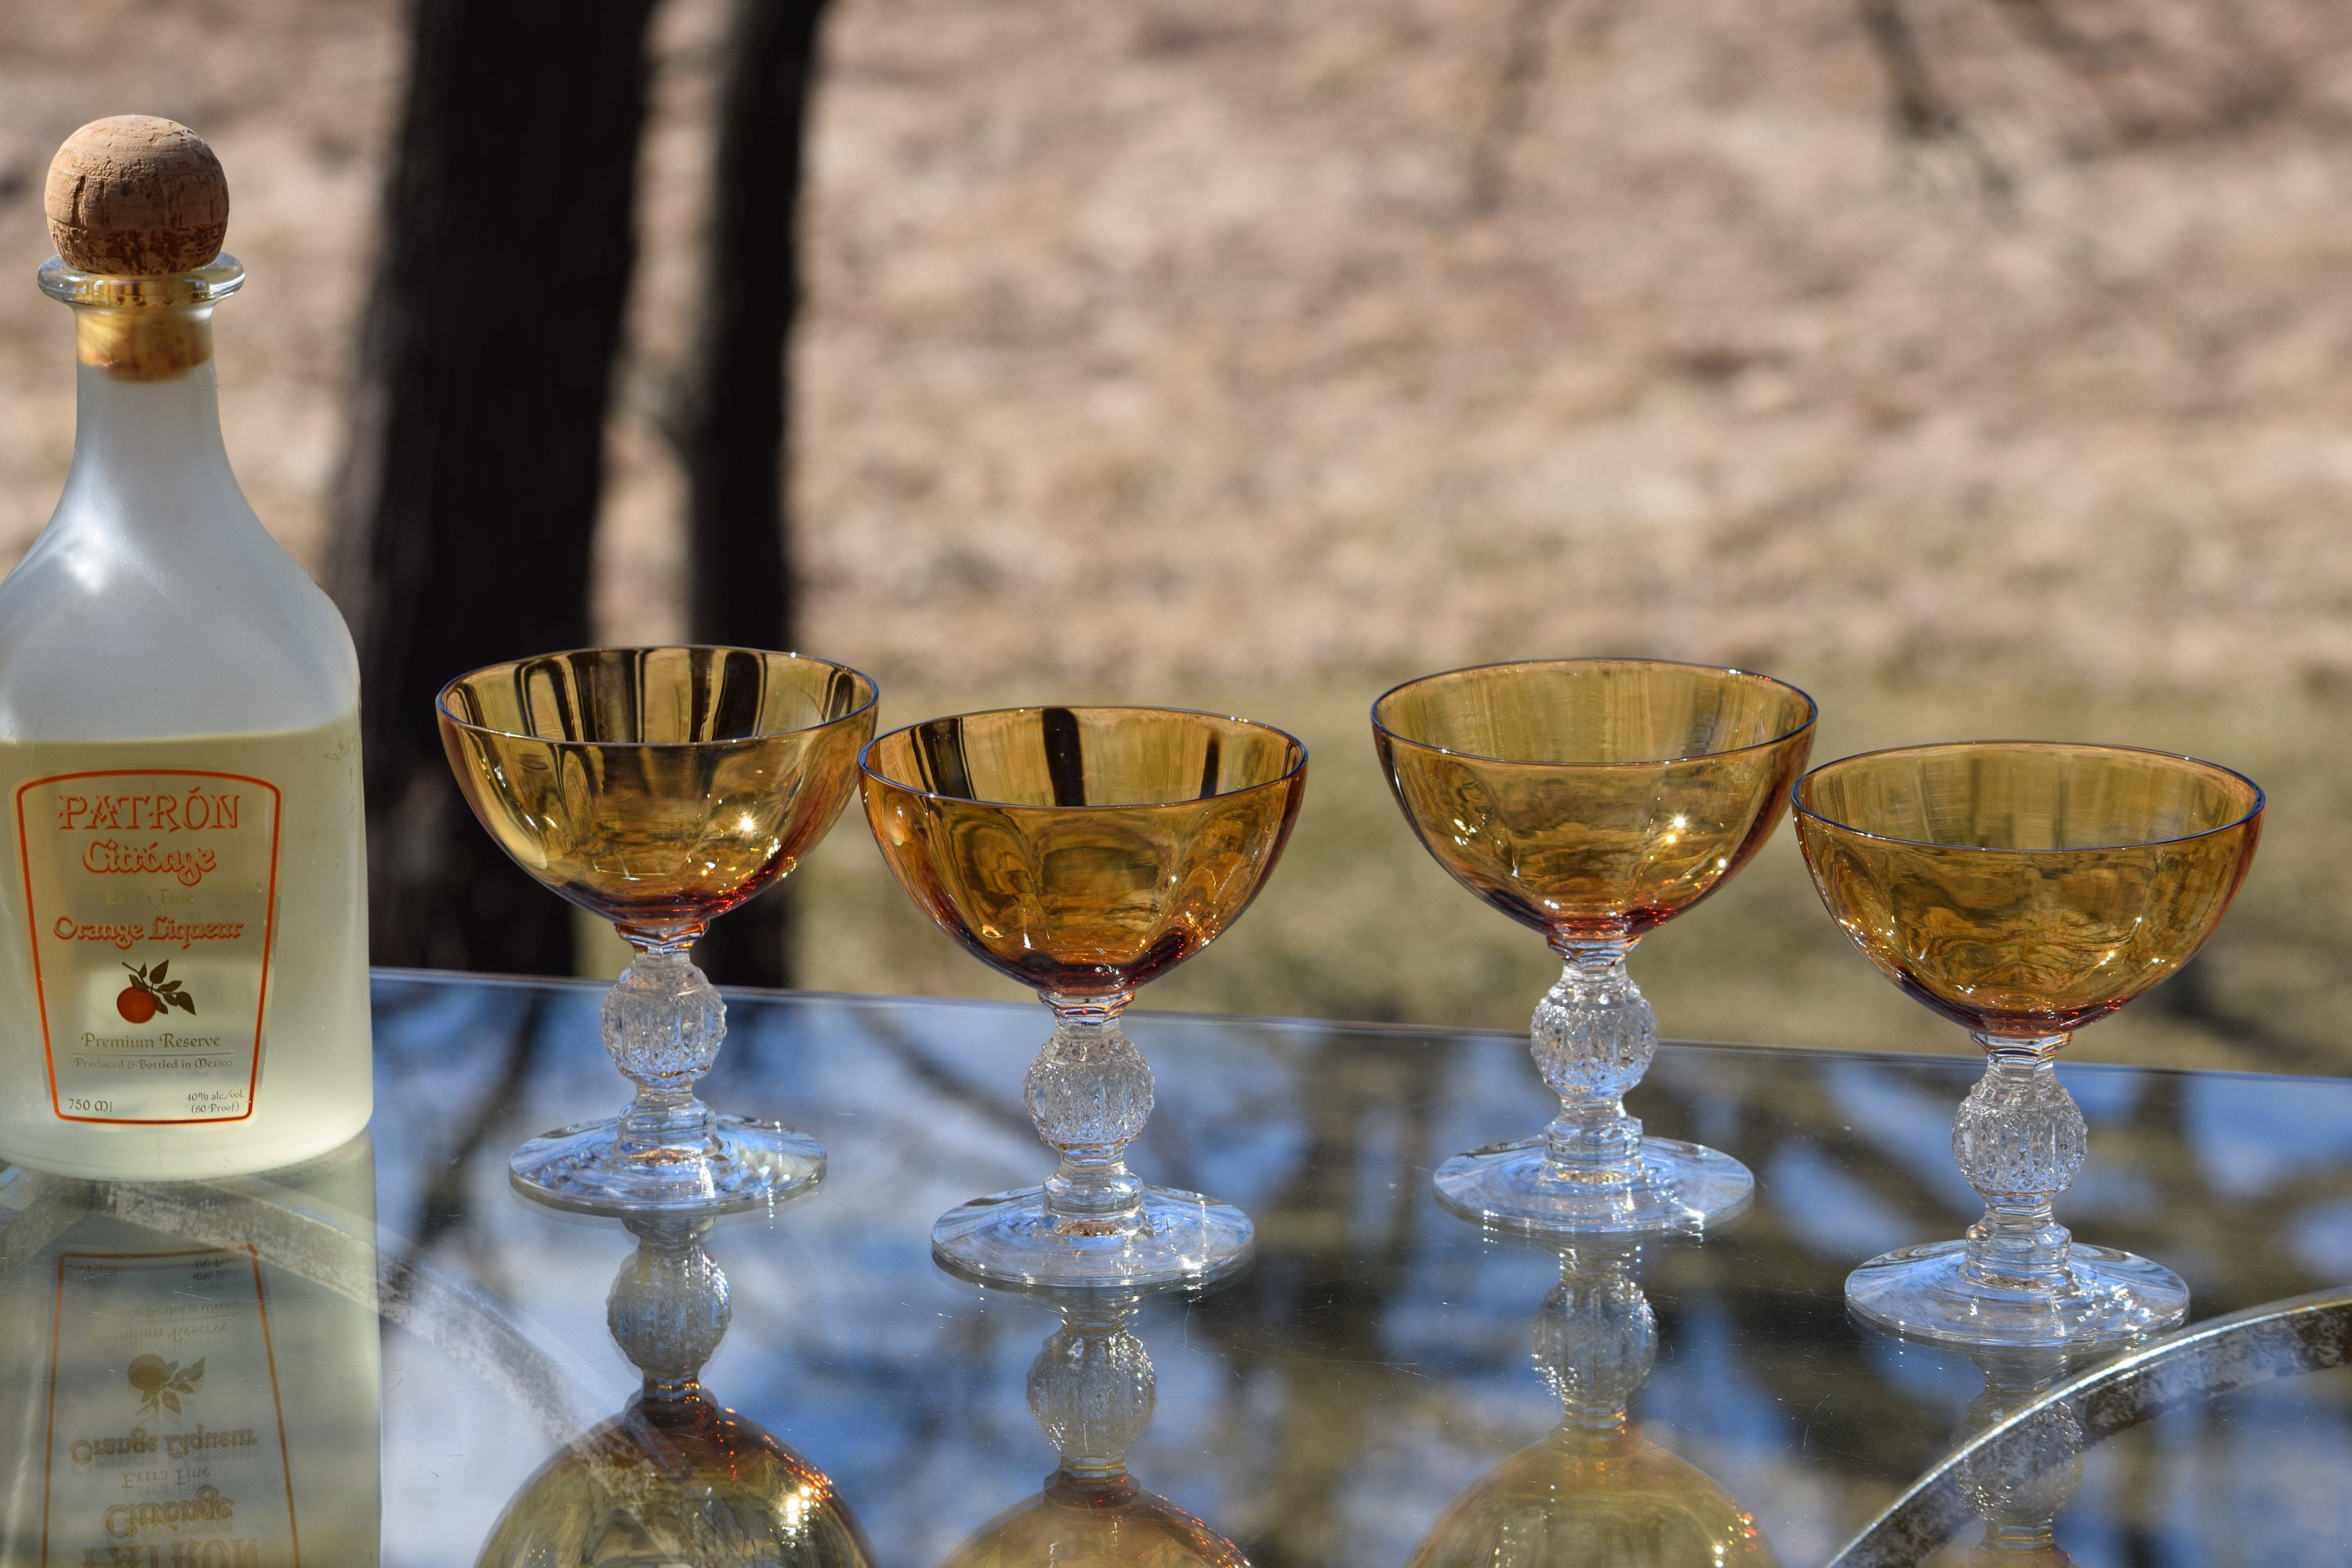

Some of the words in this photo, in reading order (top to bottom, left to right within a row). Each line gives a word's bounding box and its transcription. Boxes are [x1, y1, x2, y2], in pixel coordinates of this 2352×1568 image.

[58, 786, 241, 833] PATRÓN
[82, 838, 216, 887] Citrónge
[158, 887, 195, 906] Fine
[53, 916, 144, 950] Orange
[147, 915, 245, 950] Liqueur
[81, 1032, 155, 1049] Premium
[159, 1033, 221, 1049] Reserve
[74, 1057, 124, 1070] Produced
[126, 1059, 135, 1069] &
[137, 1058, 181, 1070] Bottled
[182, 1058, 191, 1069] in
[194, 1057, 233, 1069] Mexico
[67, 1098, 91, 1112] 750
[186, 1091, 209, 1102] 40%
[191, 1104, 207, 1114] (80
[208, 1101, 240, 1113] Proof)
